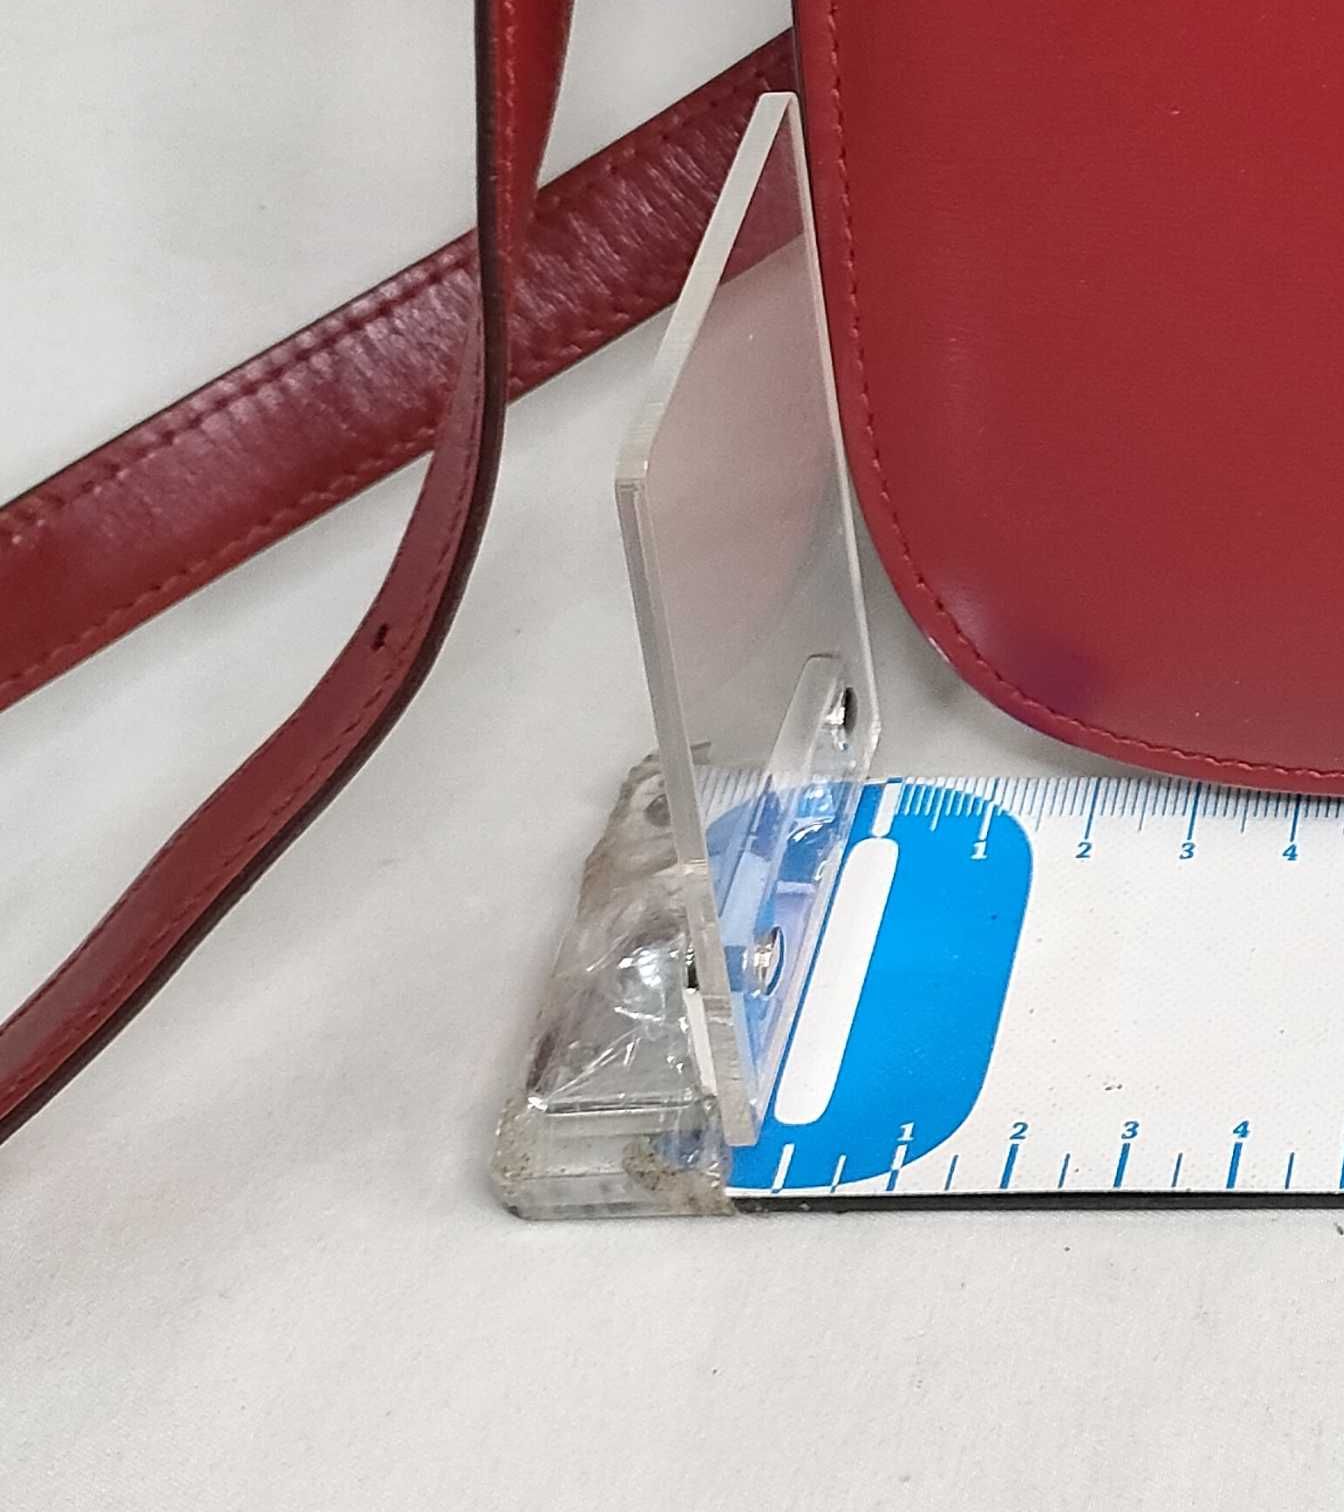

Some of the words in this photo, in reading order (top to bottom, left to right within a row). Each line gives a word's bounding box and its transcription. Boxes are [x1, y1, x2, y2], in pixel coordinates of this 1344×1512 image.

[971, 841, 988, 860] 1
[1075, 841, 1092, 860] 2
[1179, 841, 1196, 860] 3
[1282, 844, 1299, 862] 4
[703, 780, 1033, 1190] 0
[898, 1124, 915, 1140] 1
[1009, 1122, 1029, 1140] 2
[1121, 1121, 1139, 1139] 3
[1232, 1121, 1249, 1139] 4
